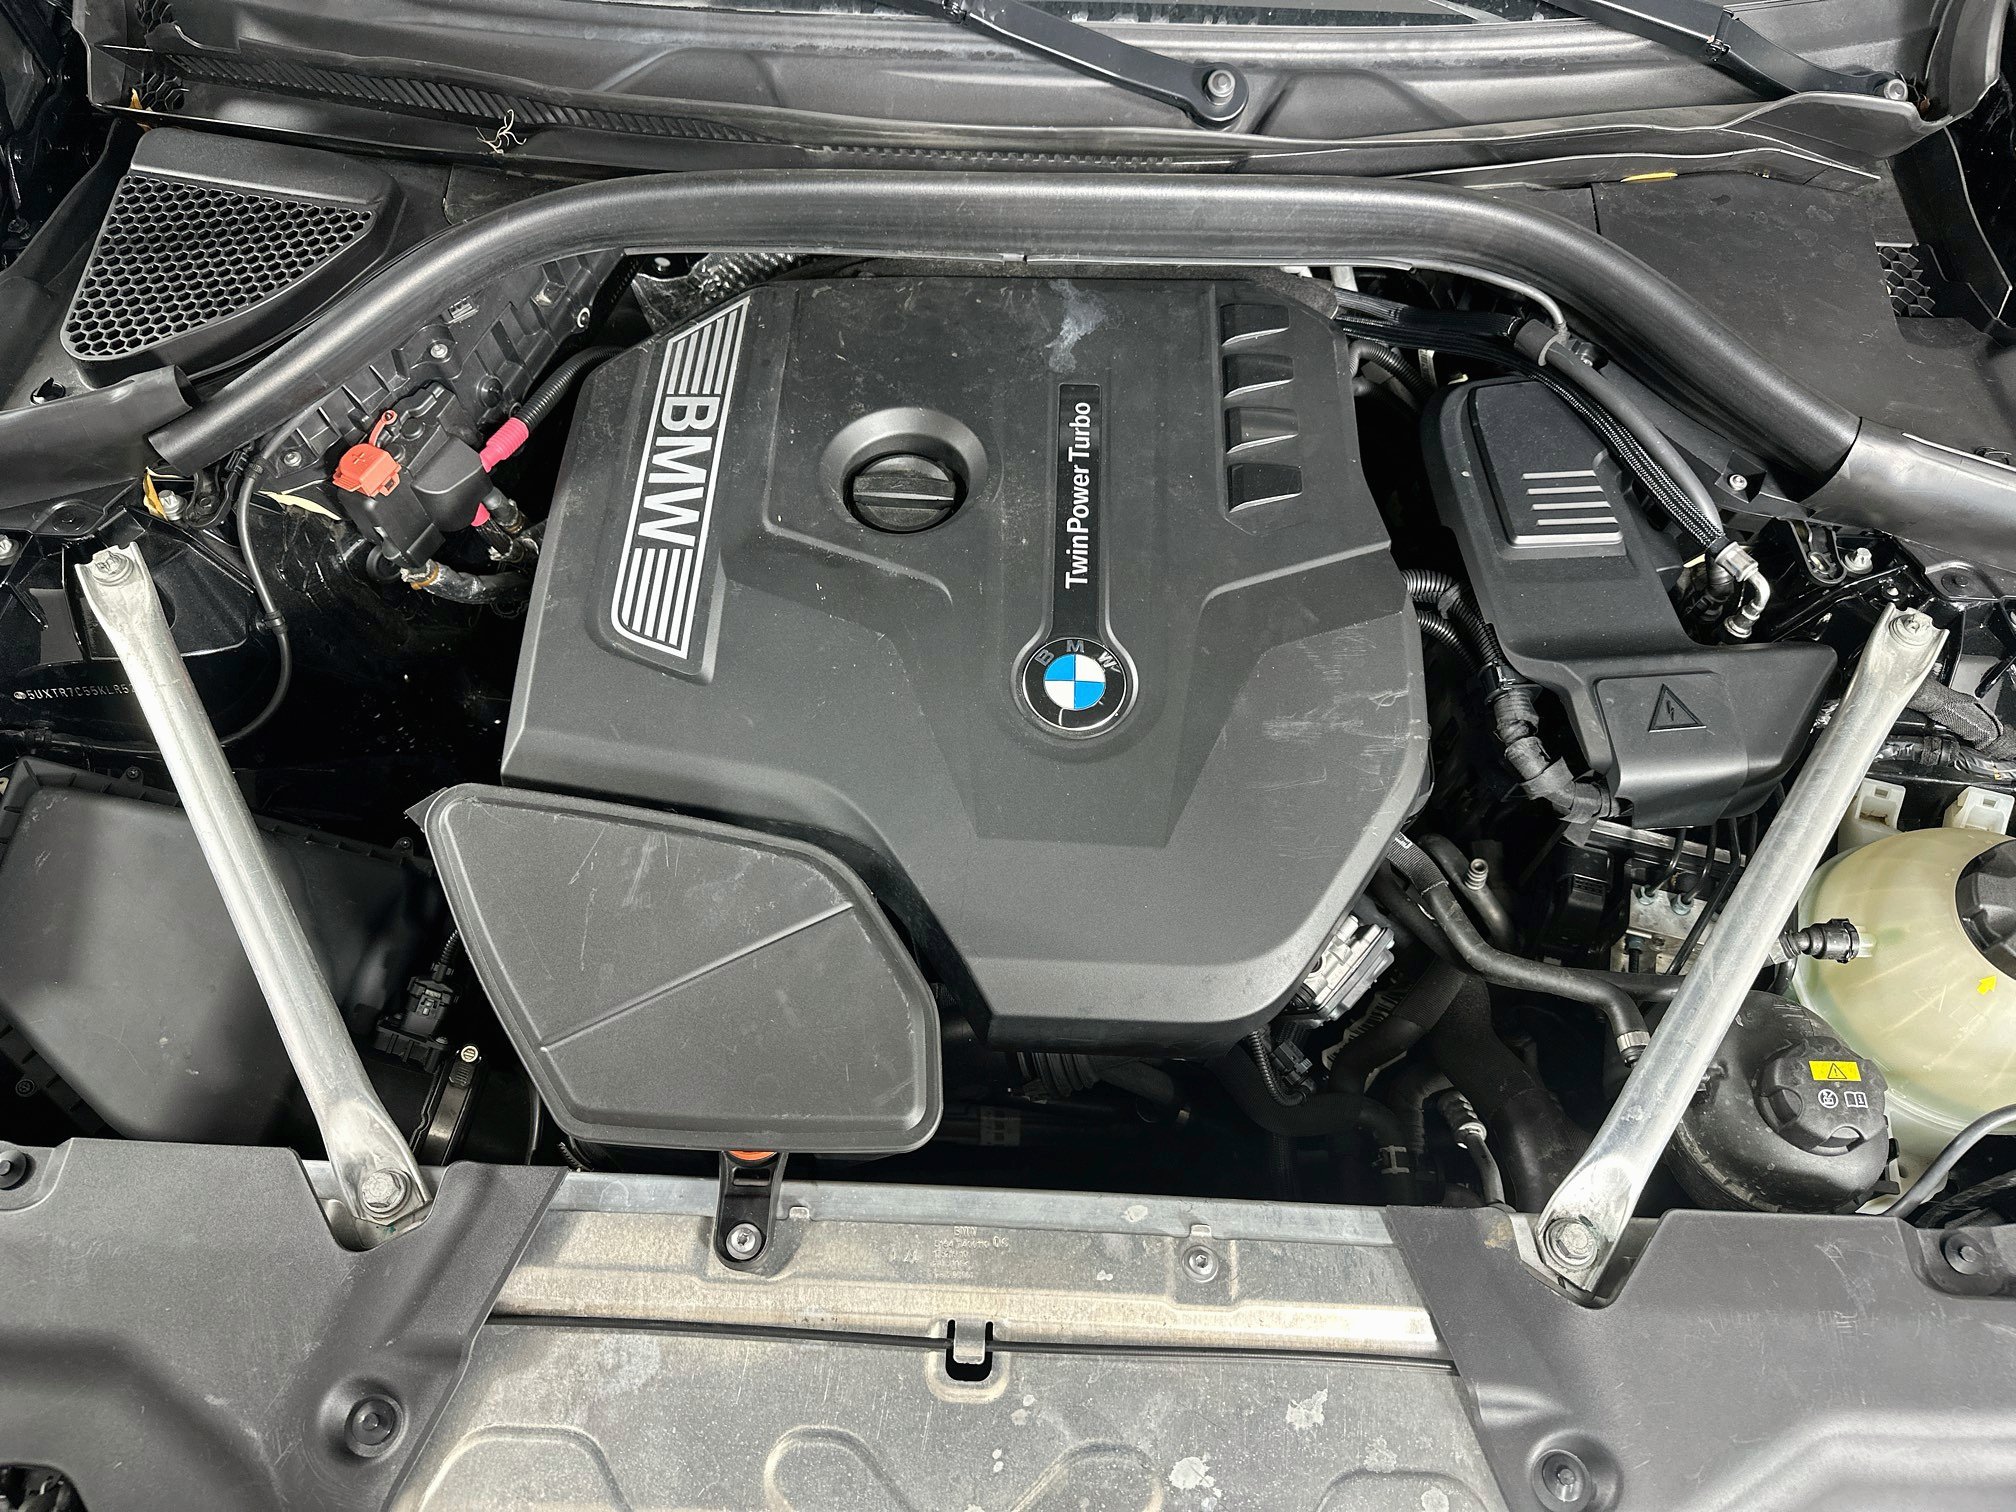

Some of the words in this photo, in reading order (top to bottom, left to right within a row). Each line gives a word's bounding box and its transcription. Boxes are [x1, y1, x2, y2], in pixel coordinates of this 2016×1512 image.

[637, 396, 721, 547] BMW
[1069, 402, 1091, 462] Turbo
[1065, 465, 1089, 589] TwinPower
[1034, 639, 1121, 673] BMW
